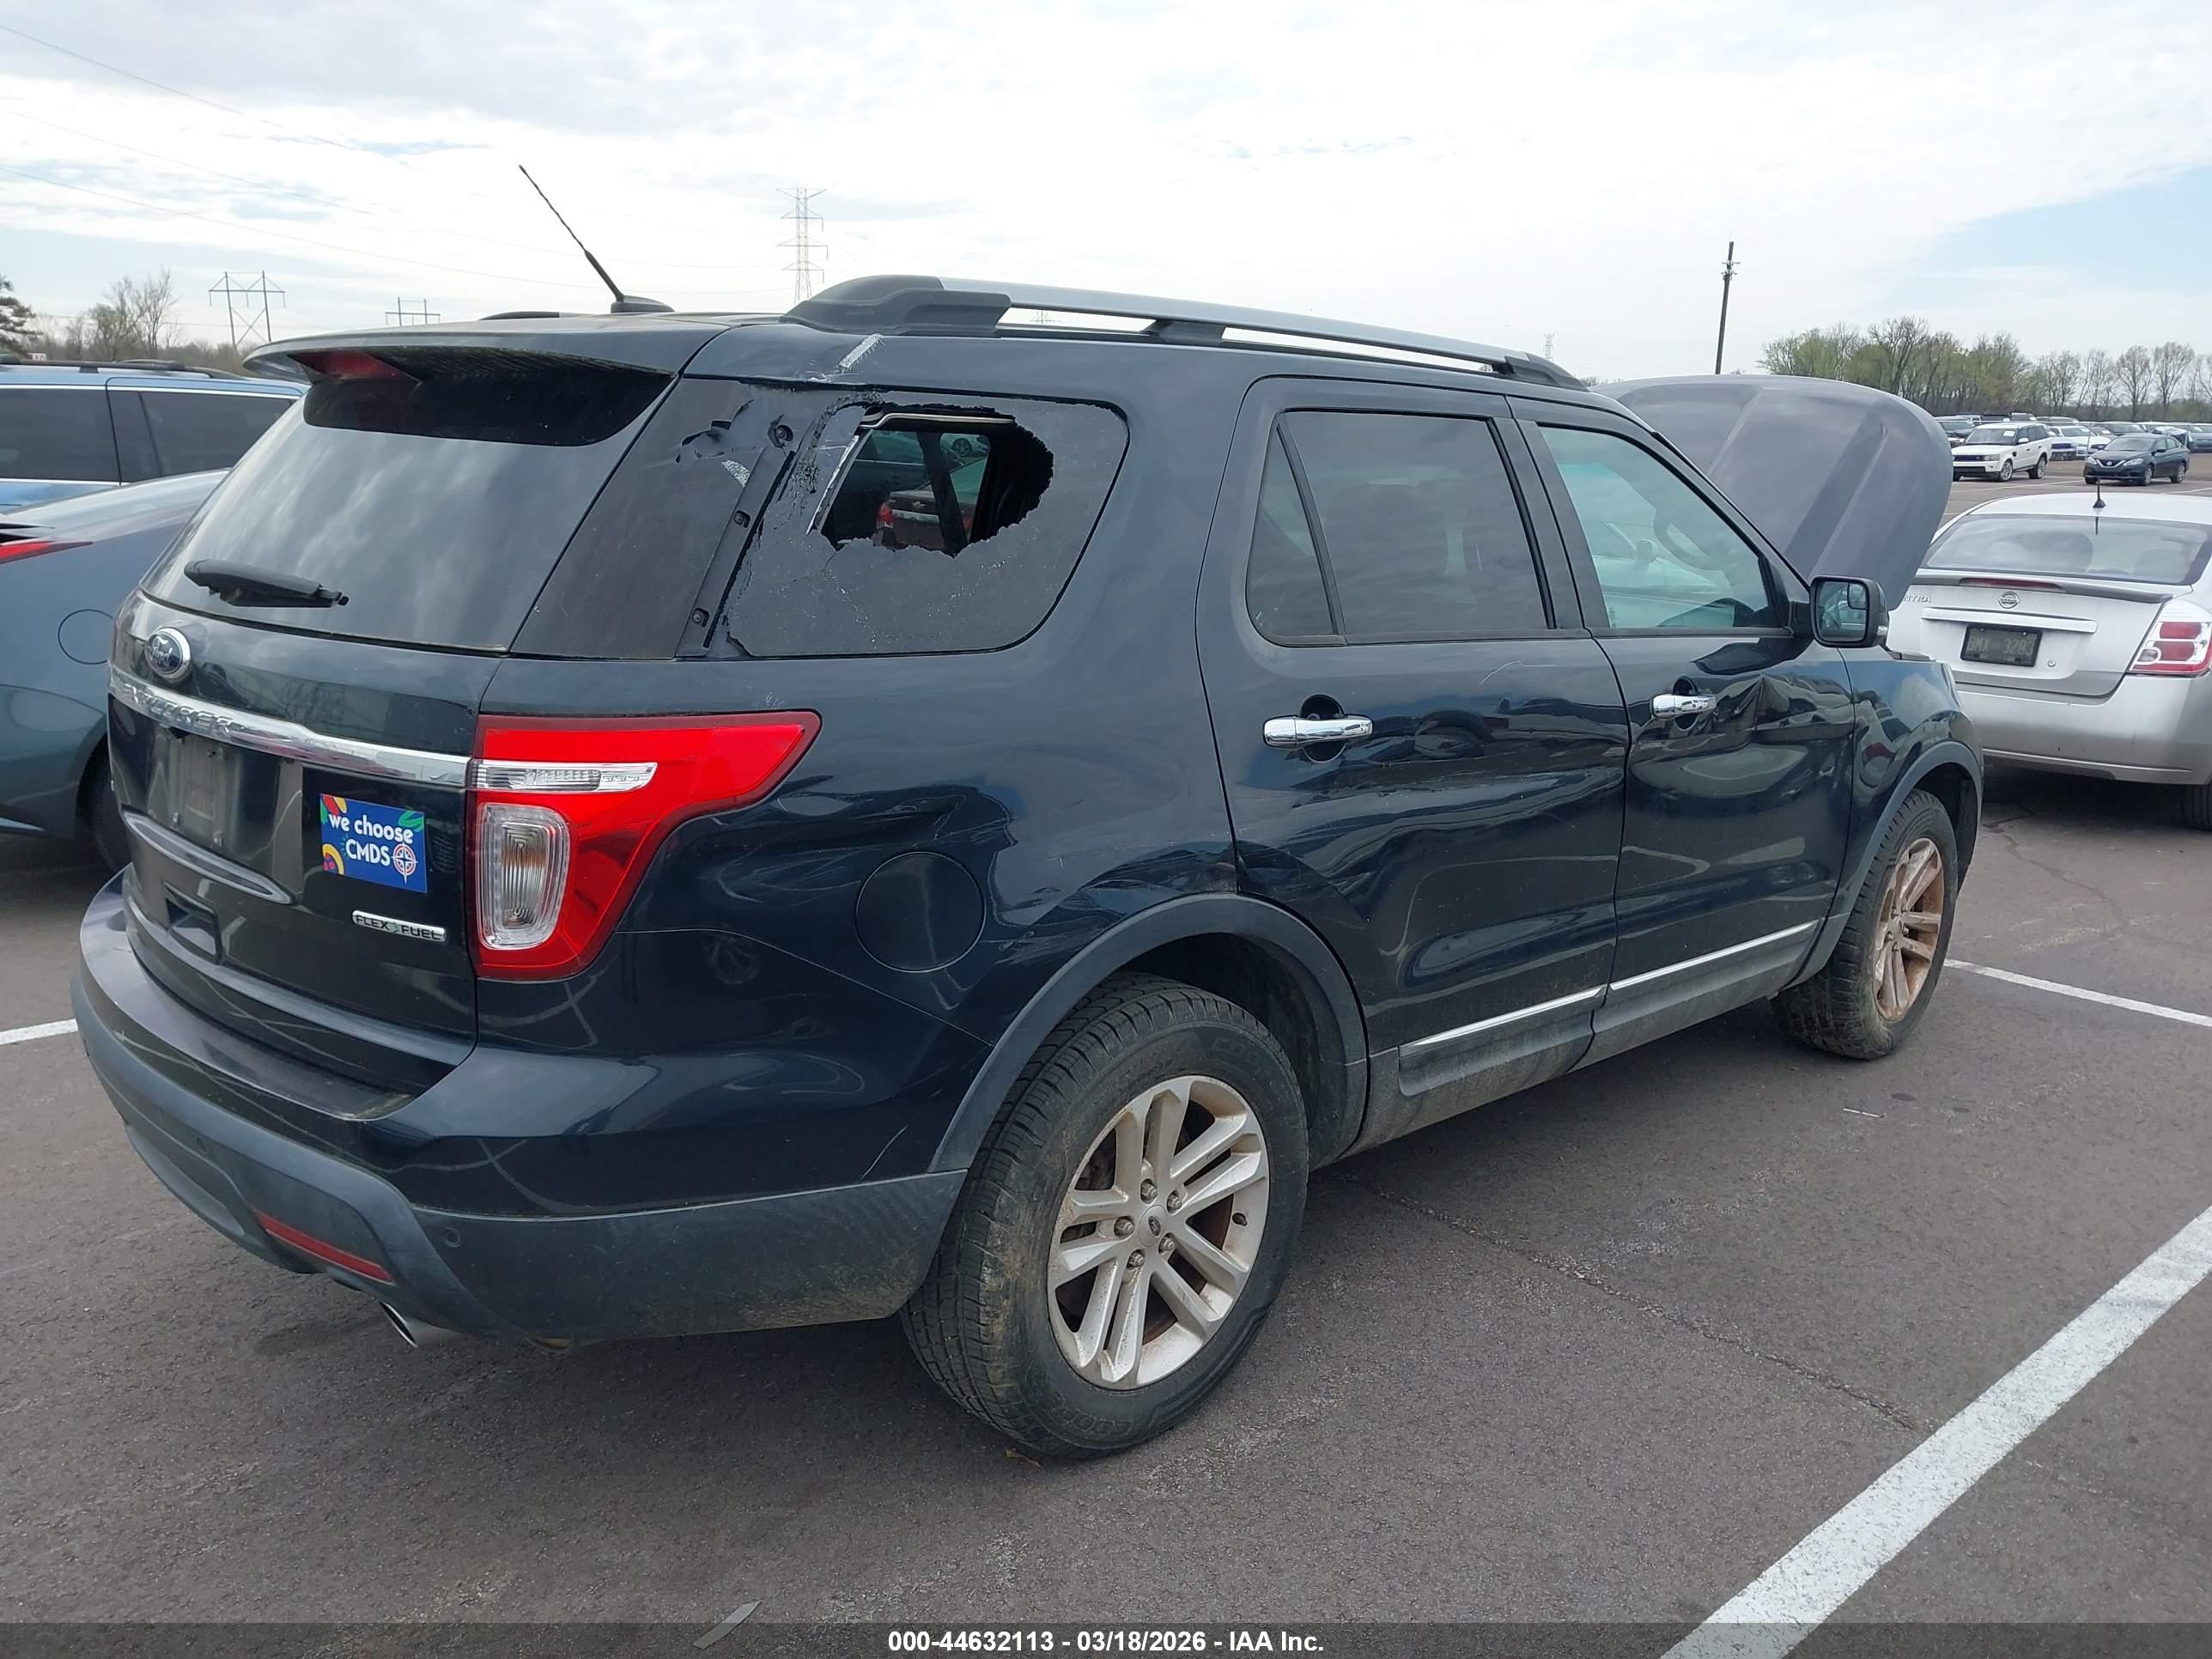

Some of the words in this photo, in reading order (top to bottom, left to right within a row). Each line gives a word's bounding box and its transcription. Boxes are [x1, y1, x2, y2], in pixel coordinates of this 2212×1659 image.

[328, 813, 350, 832] we
[354, 814, 414, 844] choose
[345, 838, 391, 866] CMDS
[356, 915, 389, 932] FLEX
[402, 924, 443, 940] FUEL
